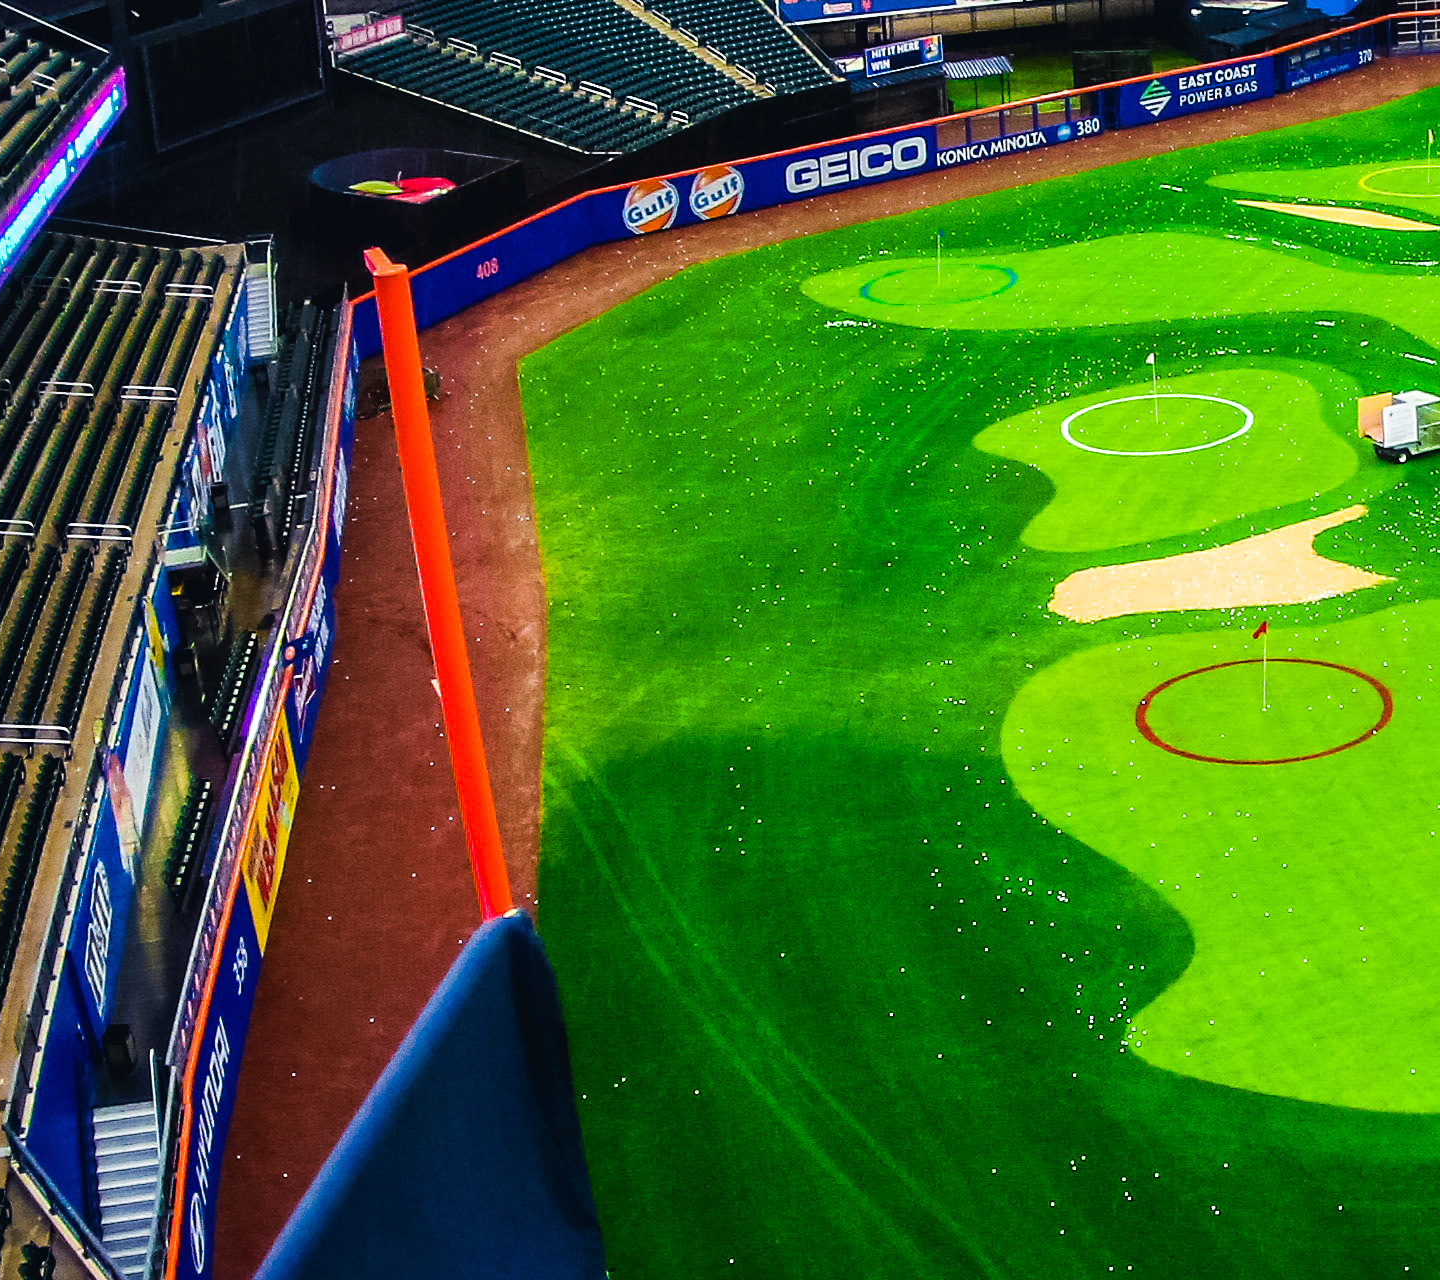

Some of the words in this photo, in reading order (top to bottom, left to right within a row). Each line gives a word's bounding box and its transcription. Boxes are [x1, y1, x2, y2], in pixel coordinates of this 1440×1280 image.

[871, 48, 887, 59] HIT
[887, 46, 896, 56] IT
[896, 40, 920, 54] HERE
[1358, 48, 1373, 65] 370
[871, 59, 891, 72] WIN
[1178, 72, 1212, 90] EAST
[1214, 63, 1257, 83] COAST
[1179, 90, 1223, 107] POWER
[1224, 87, 1233, 98] &
[1234, 80, 1258, 95] GAS
[1076, 117, 1100, 137] 380
[936, 143, 989, 167] KONICA
[989, 131, 1047, 156] MINOLTA
[785, 136, 927, 194] GEICO
[693, 176, 739, 210] Gulf
[627, 190, 675, 224] Gulf
[198, 1013, 230, 1207] HYUNDAI
